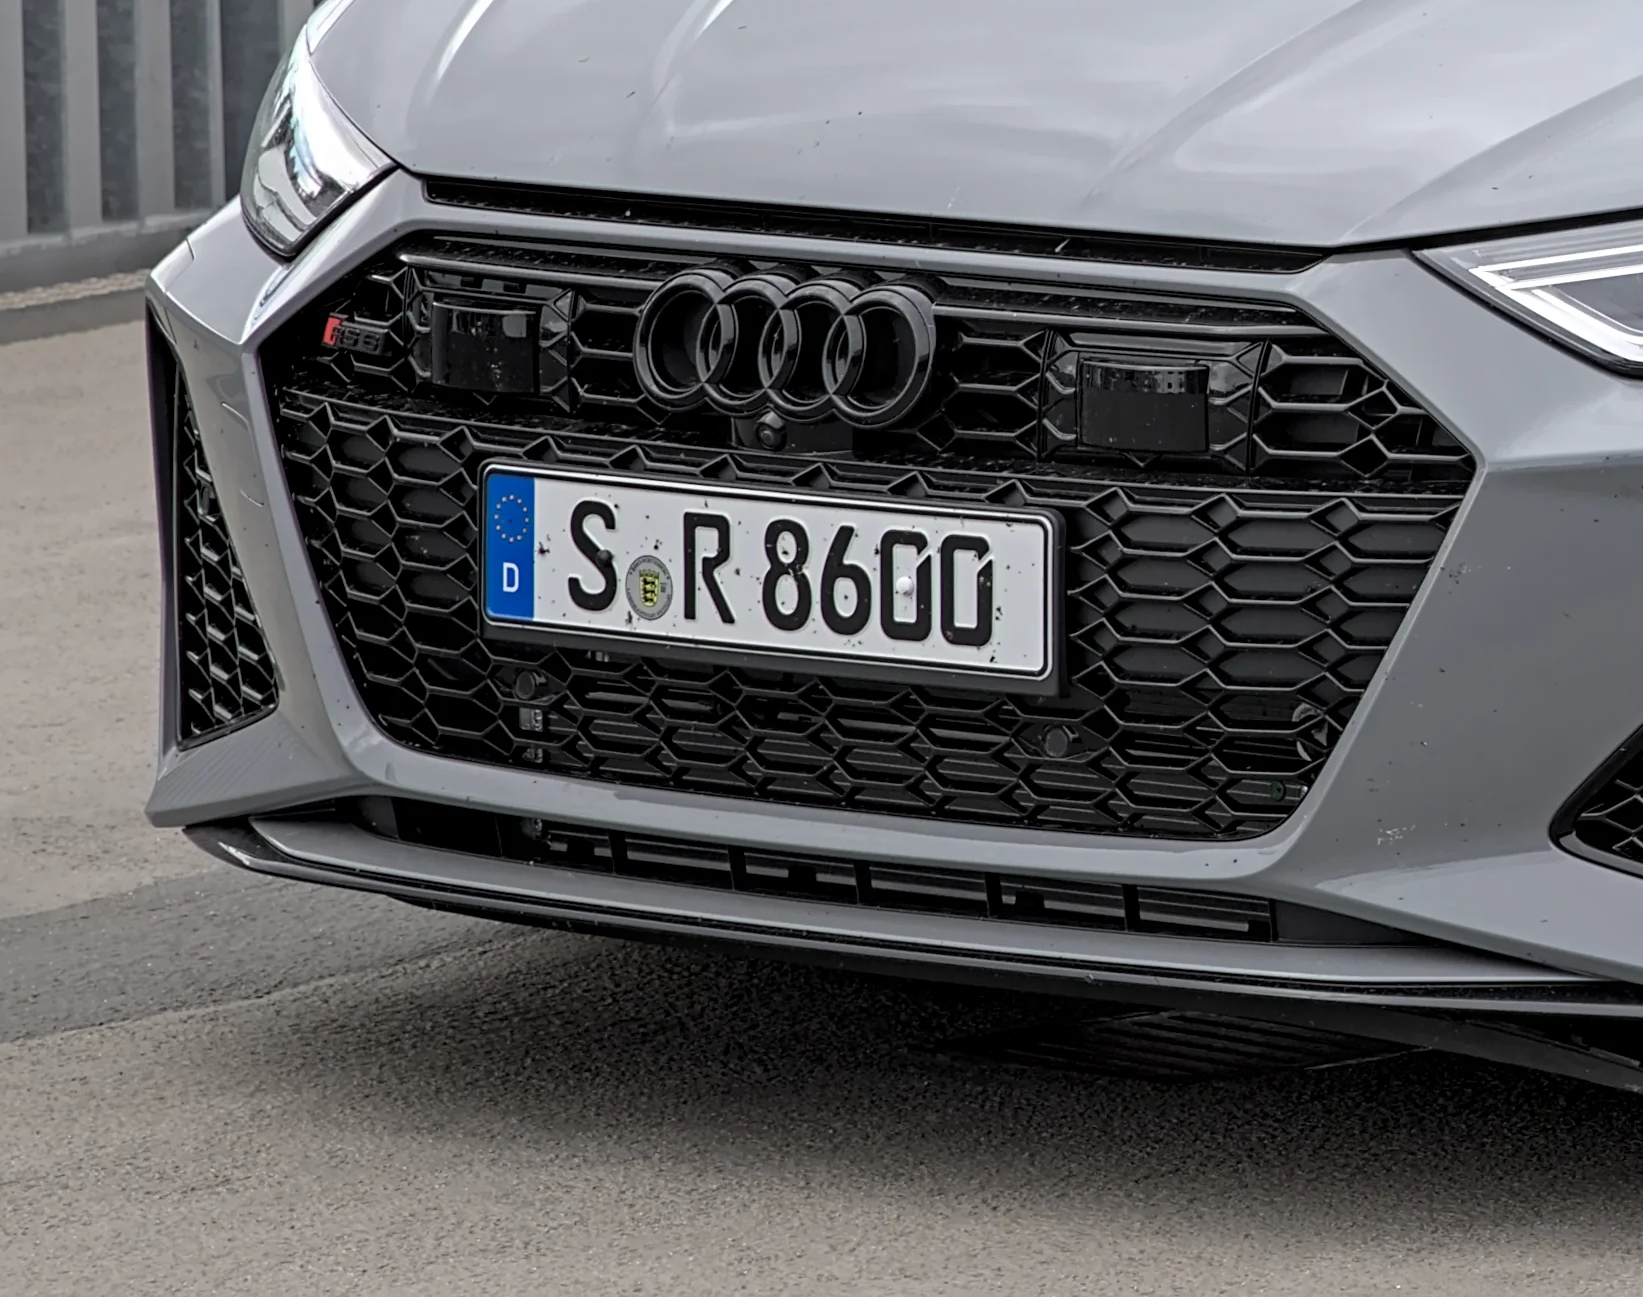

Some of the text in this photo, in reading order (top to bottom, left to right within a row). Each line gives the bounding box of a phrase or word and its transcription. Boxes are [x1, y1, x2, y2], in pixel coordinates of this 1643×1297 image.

[503, 562, 520, 592] D
[567, 499, 617, 611] S
[682, 511, 736, 625] R
[761, 518, 995, 647] 8600
